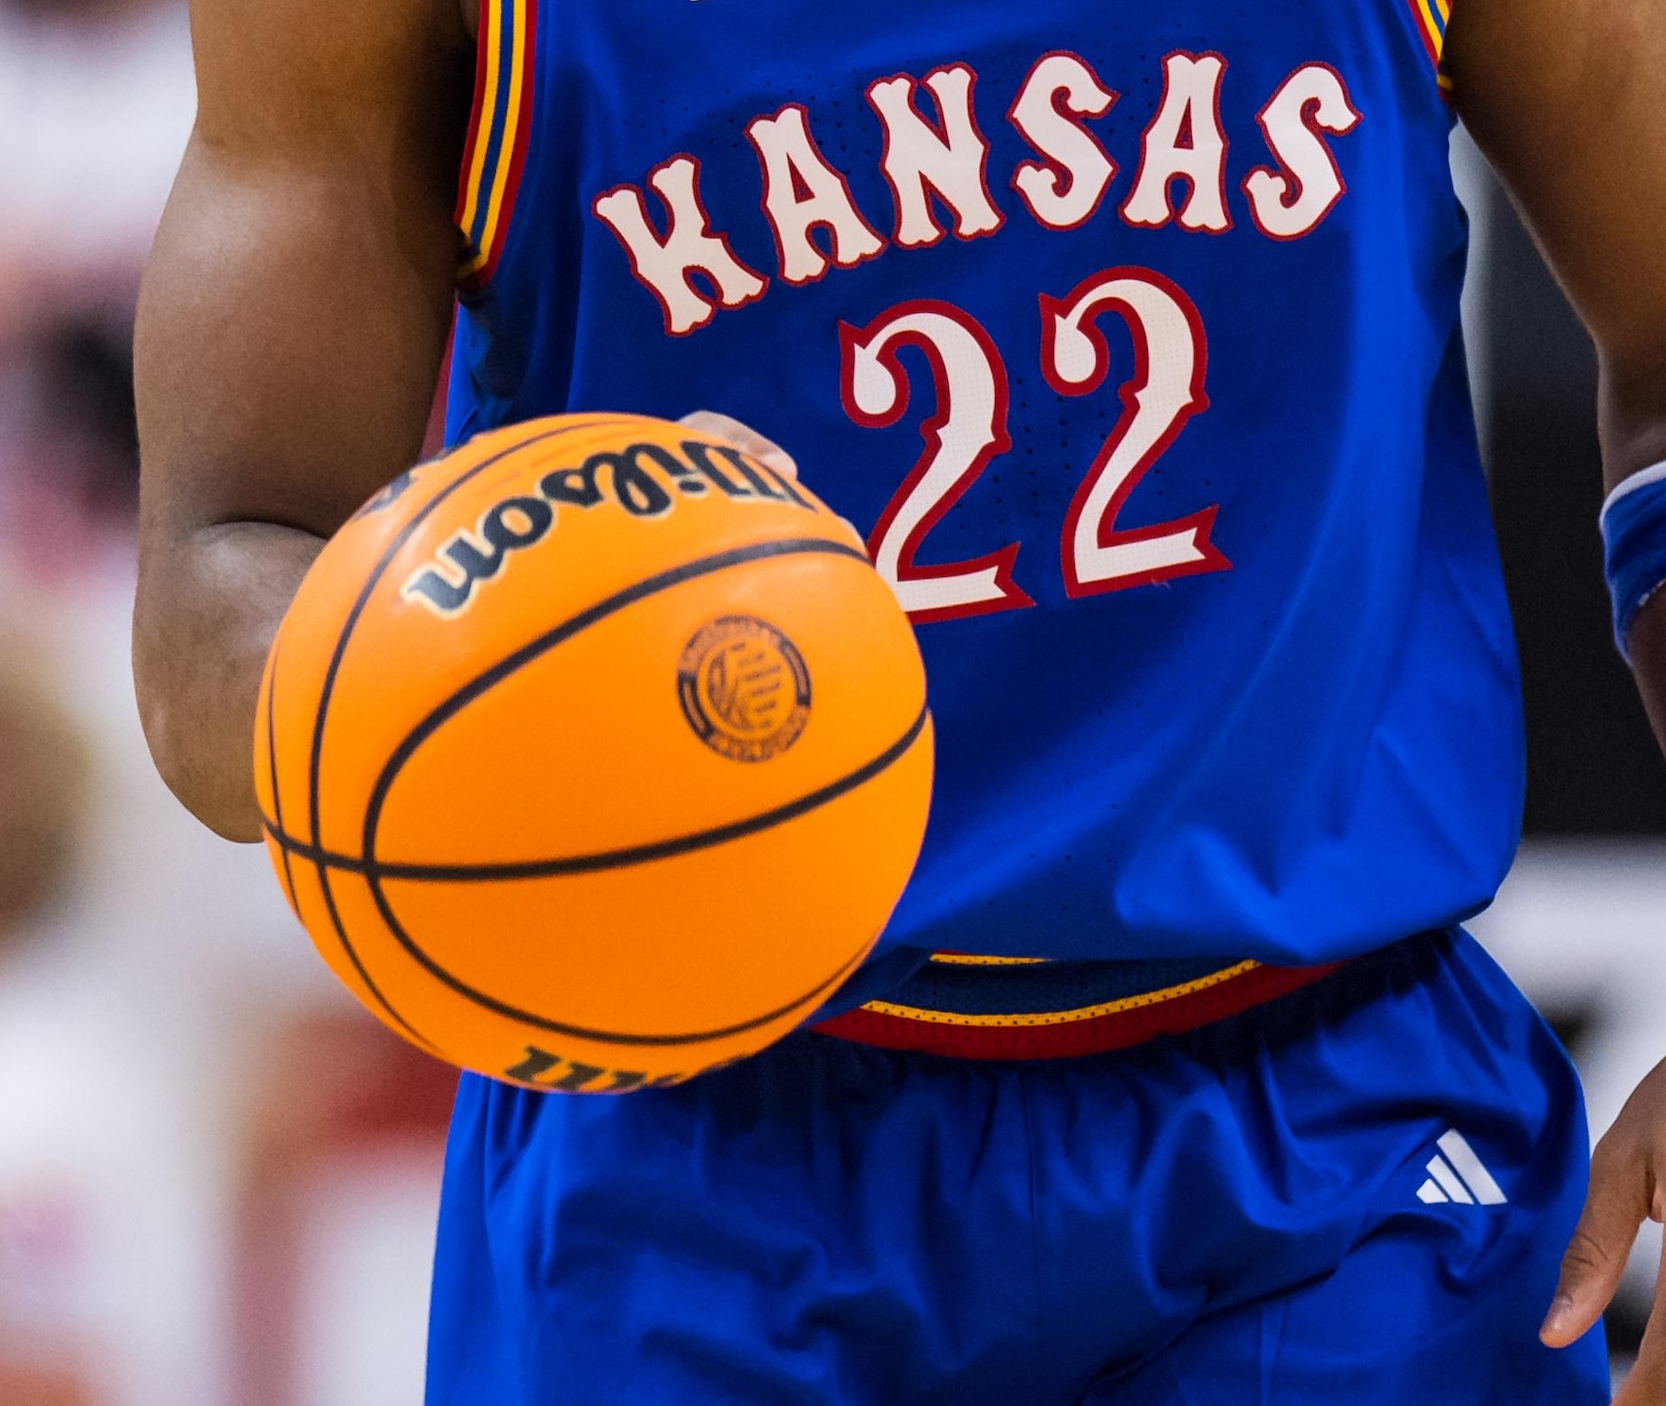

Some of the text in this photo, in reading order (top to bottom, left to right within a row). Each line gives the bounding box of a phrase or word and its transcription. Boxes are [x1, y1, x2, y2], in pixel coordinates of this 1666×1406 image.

[594, 51, 1363, 336] KANSAS
[401, 439, 819, 620] Wilson
[838, 265, 1234, 624] 22
